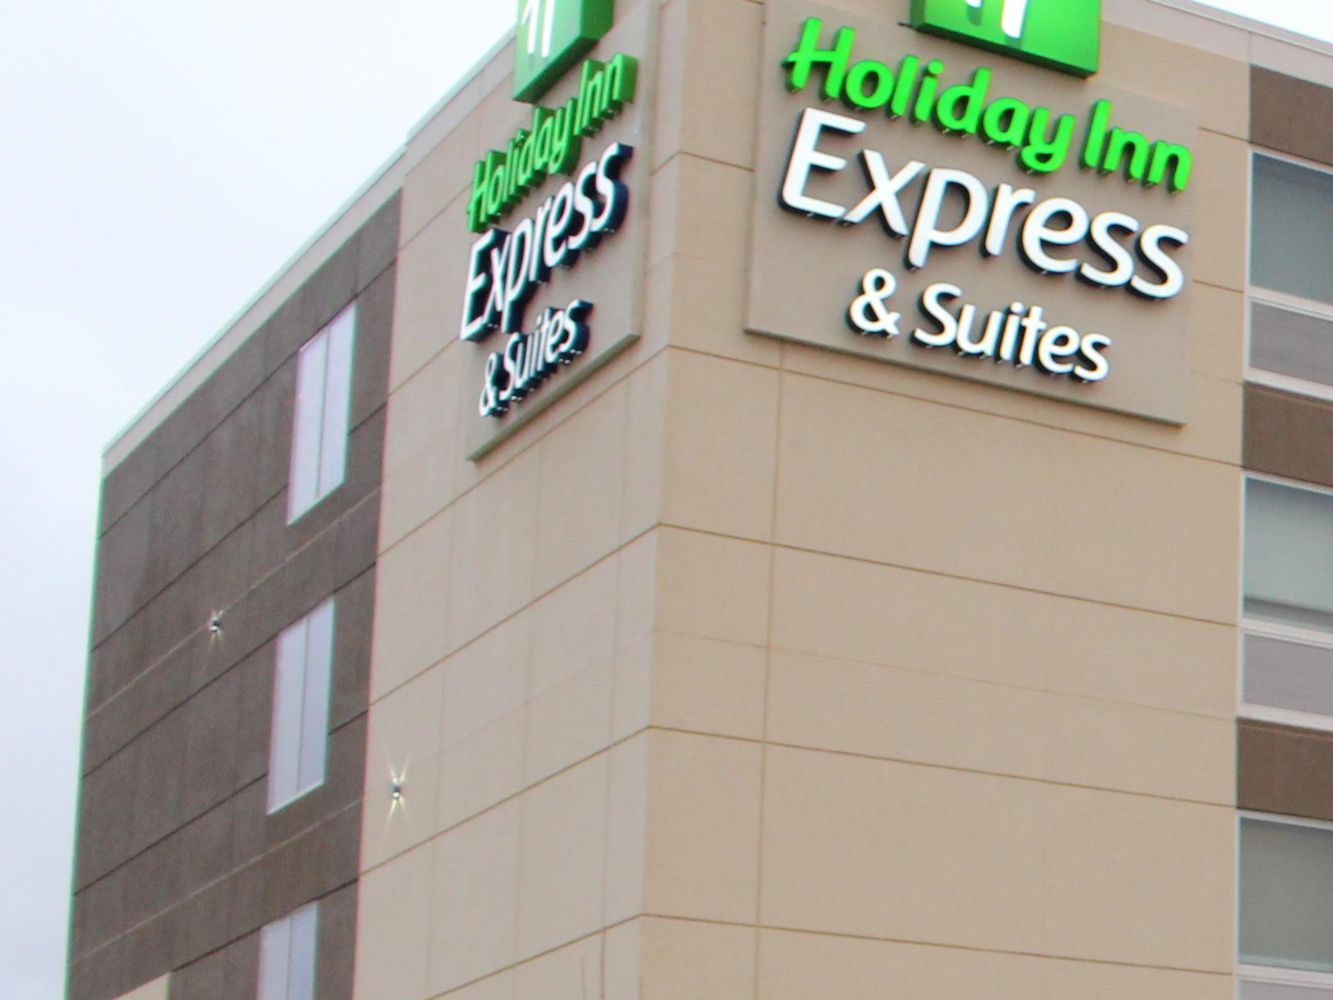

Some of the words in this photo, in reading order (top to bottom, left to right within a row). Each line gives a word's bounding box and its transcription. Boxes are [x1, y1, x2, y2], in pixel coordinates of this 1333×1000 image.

[466, 98, 579, 233] Holiday
[574, 53, 634, 136] Inn
[781, 16, 1076, 173] Holiday
[1082, 99, 1193, 193] Inn
[460, 142, 628, 342] Express
[780, 107, 1189, 300] Express
[480, 352, 504, 416] &
[500, 299, 588, 401] Suites
[848, 268, 901, 337] &
[913, 282, 1112, 382] Suites
